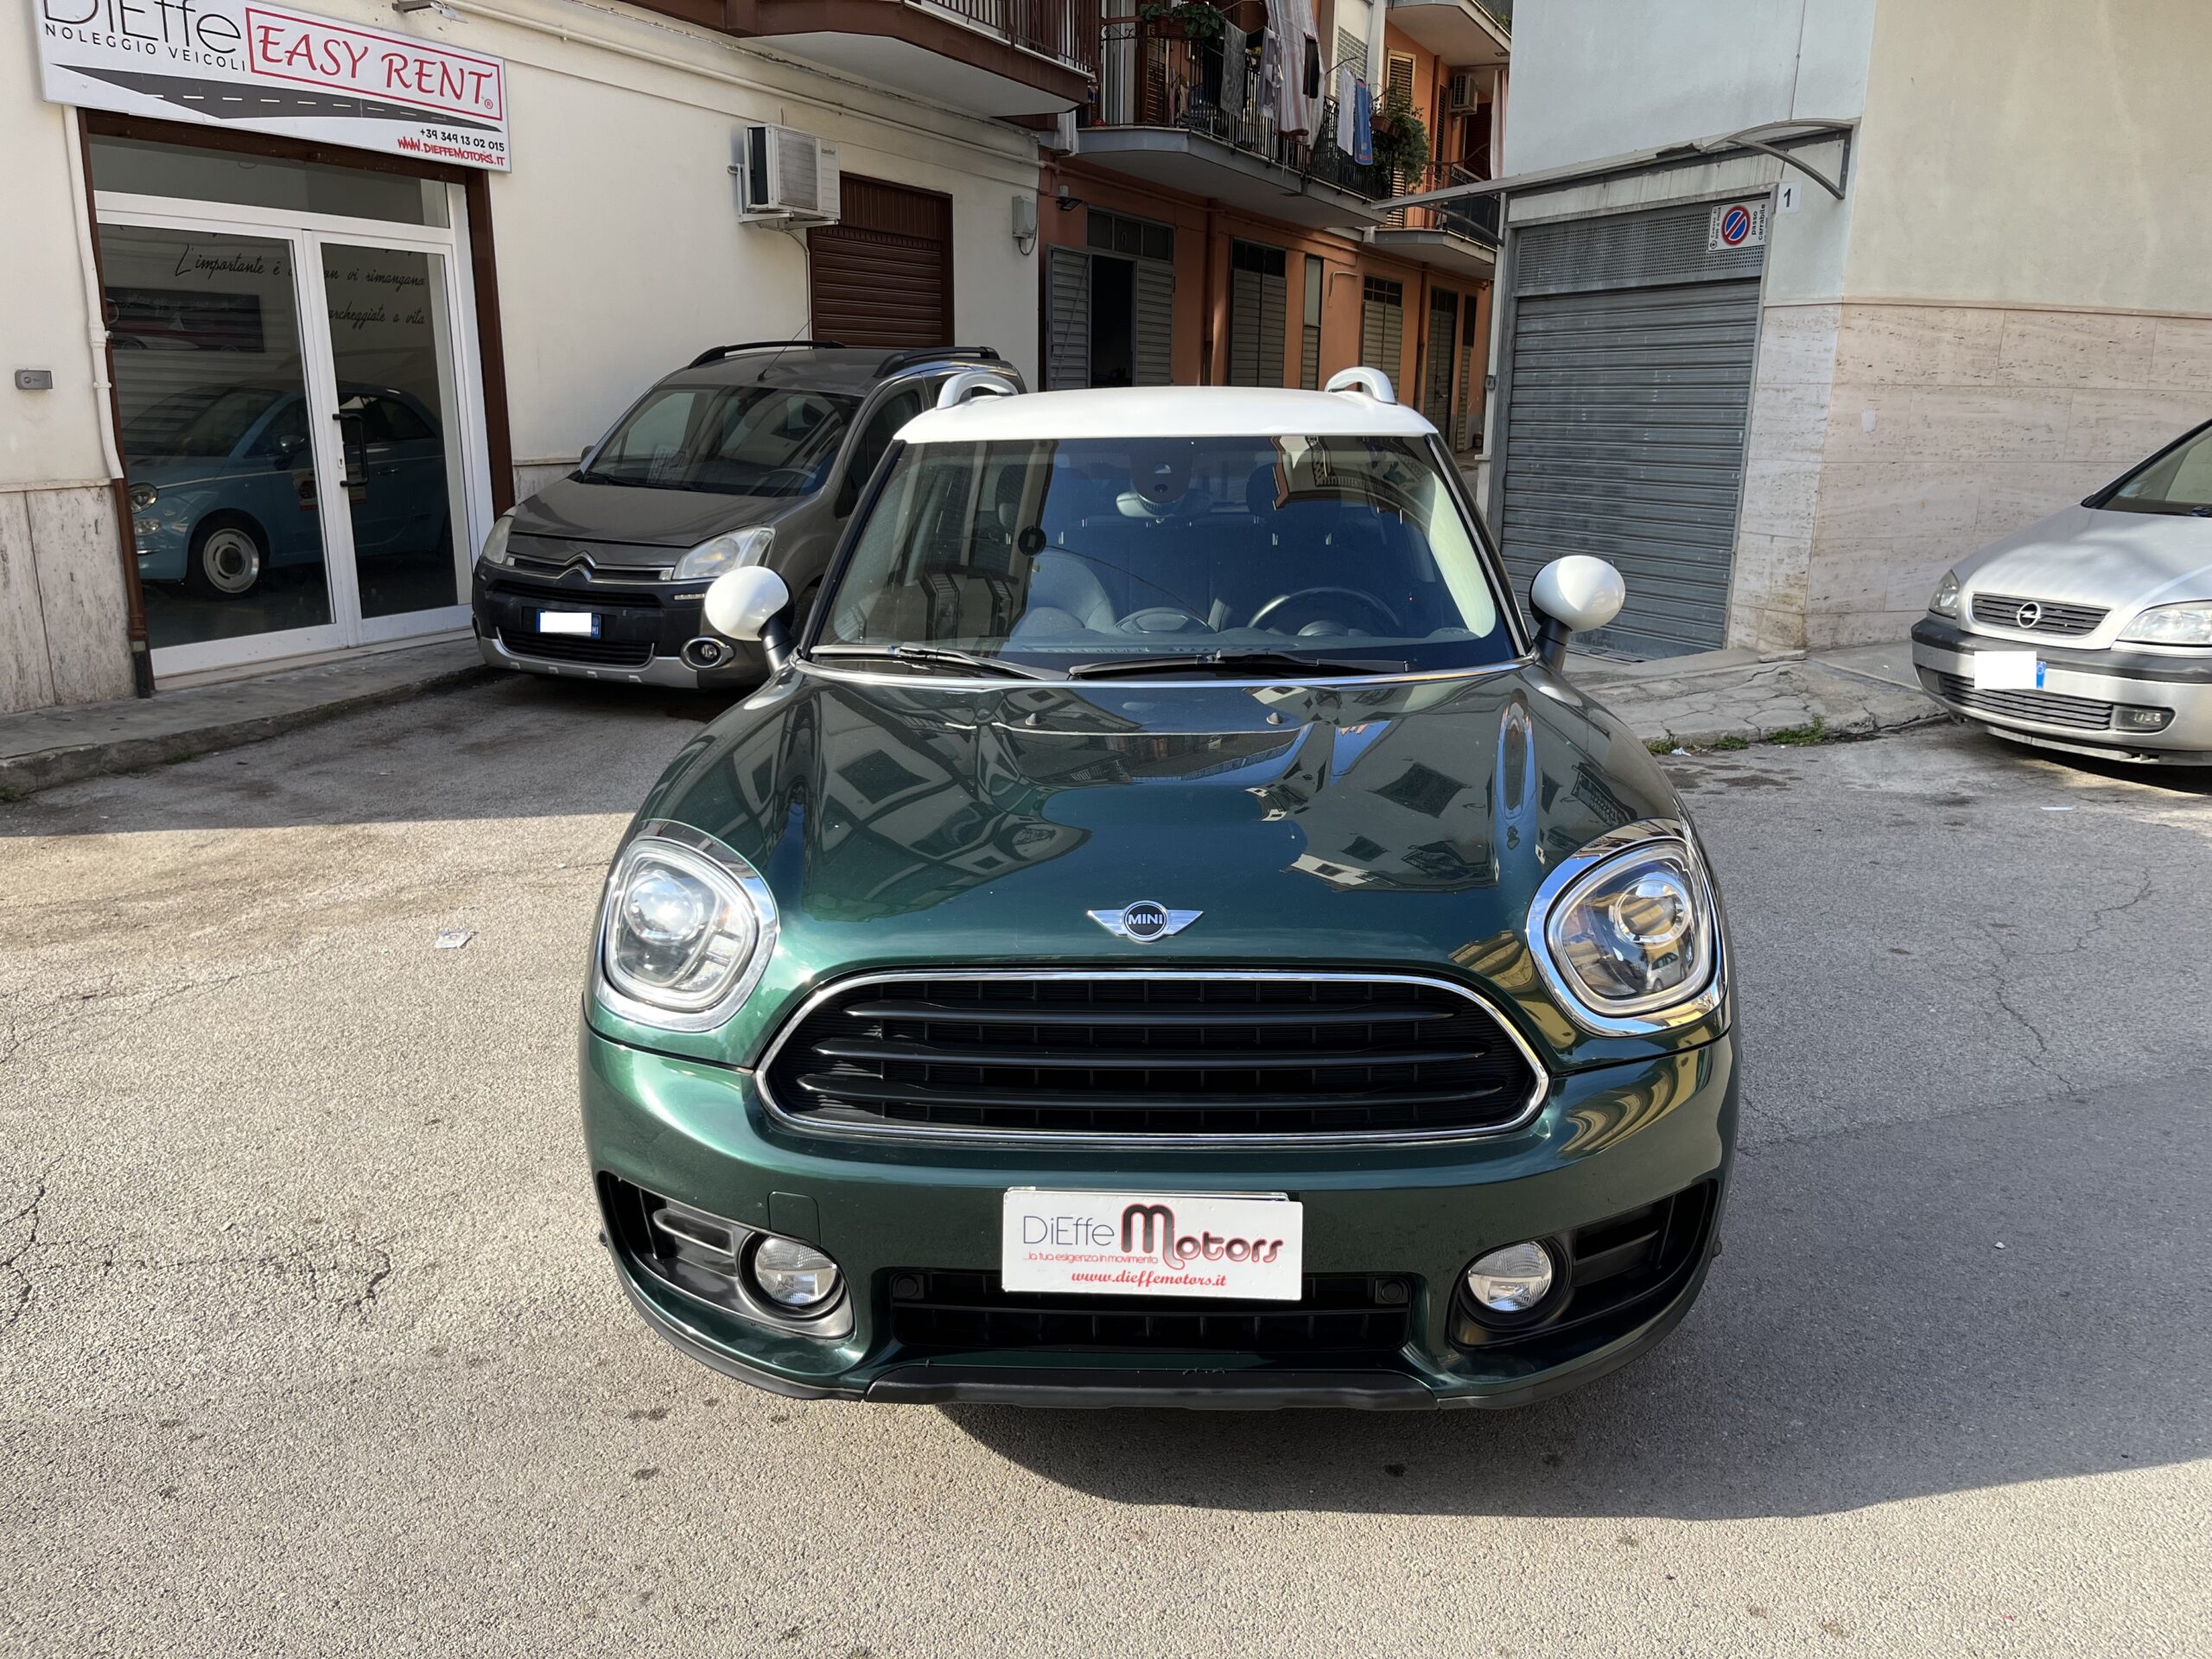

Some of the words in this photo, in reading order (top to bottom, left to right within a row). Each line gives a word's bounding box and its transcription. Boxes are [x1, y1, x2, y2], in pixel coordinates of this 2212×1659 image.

[45, 22, 156, 55] NOLEGGIO
[168, 46, 246, 72] VEICOLI
[257, 24, 369, 79] EASY
[381, 52, 493, 105] RENT
[420, 128, 438, 139] +39
[441, 131, 459, 143] 349
[461, 135, 471, 146] 13
[474, 138, 486, 149] 02
[488, 141, 505, 152] 015
[1783, 188, 1792, 208] 1
[324, 270, 340, 279] on
[328, 301, 386, 330] archeggiate
[405, 307, 425, 324] vita
[1128, 914, 1163, 925] MINI
[1023, 1215, 1115, 1247] DiEffe
[1039, 1252, 1054, 1262] tua
[1055, 1253, 1099, 1264] esigenza
[1100, 1253, 1107, 1262] in
[1108, 1254, 1159, 1264] movimento
[1071, 1270, 1227, 1287] www.dieffemotors.it
